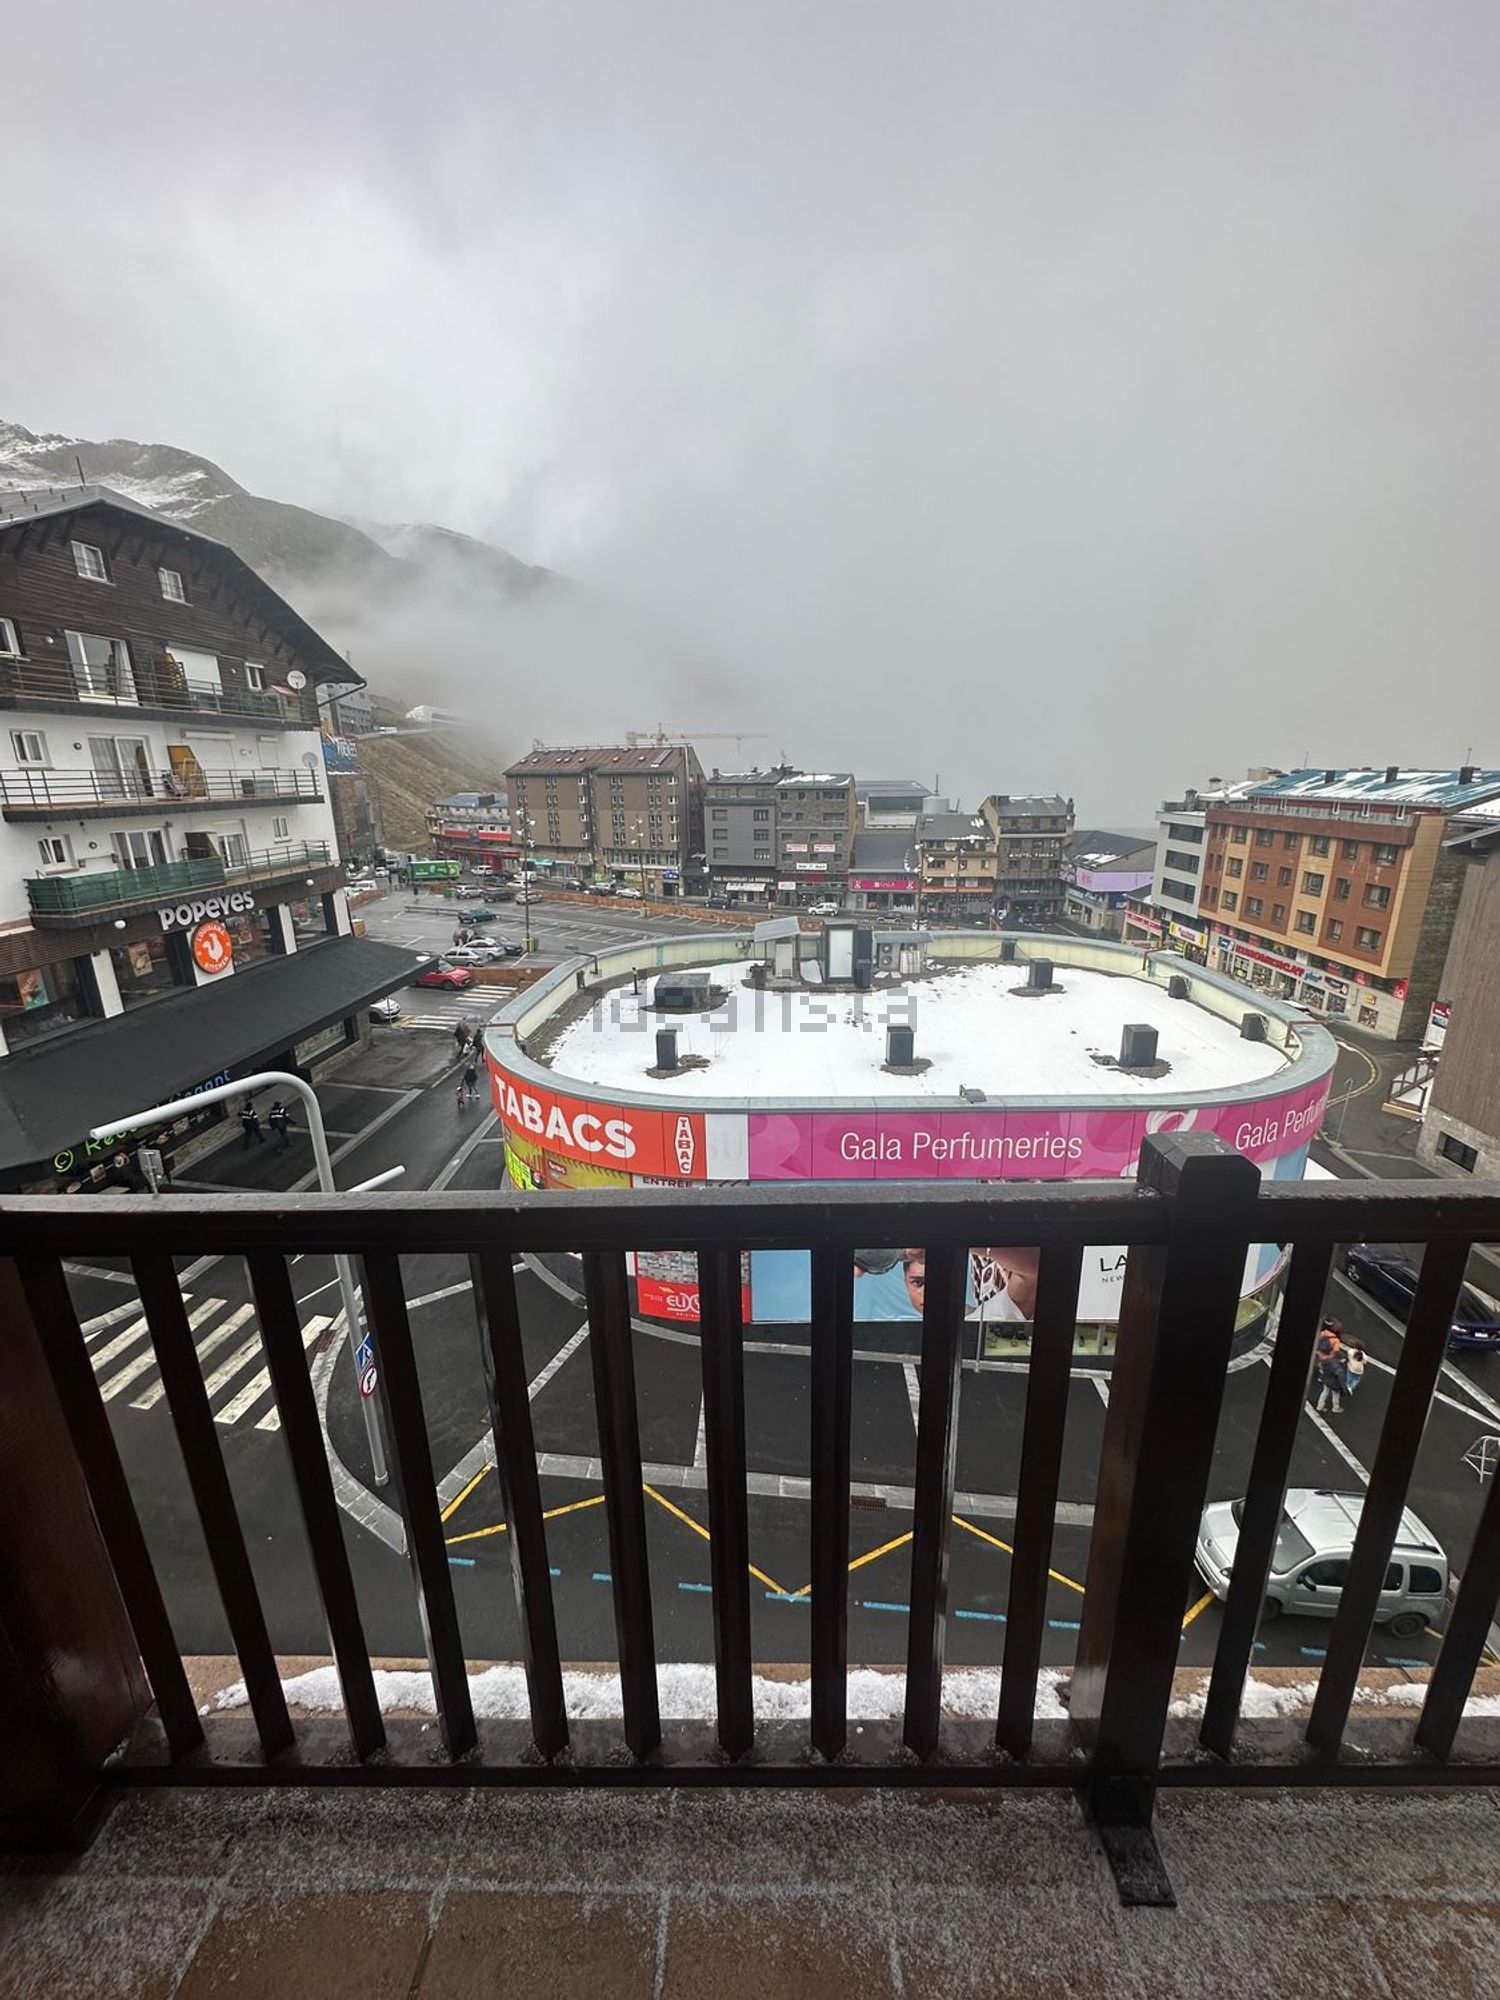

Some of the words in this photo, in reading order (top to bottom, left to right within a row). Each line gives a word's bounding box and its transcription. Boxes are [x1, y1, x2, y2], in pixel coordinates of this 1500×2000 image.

[494, 1073, 636, 1159] TABACS
[1235, 1117, 1279, 1151] Gala
[678, 1118, 693, 1172] TABAC
[840, 1132, 902, 1161] Gala
[913, 1131, 1083, 1160] Perfumeries
